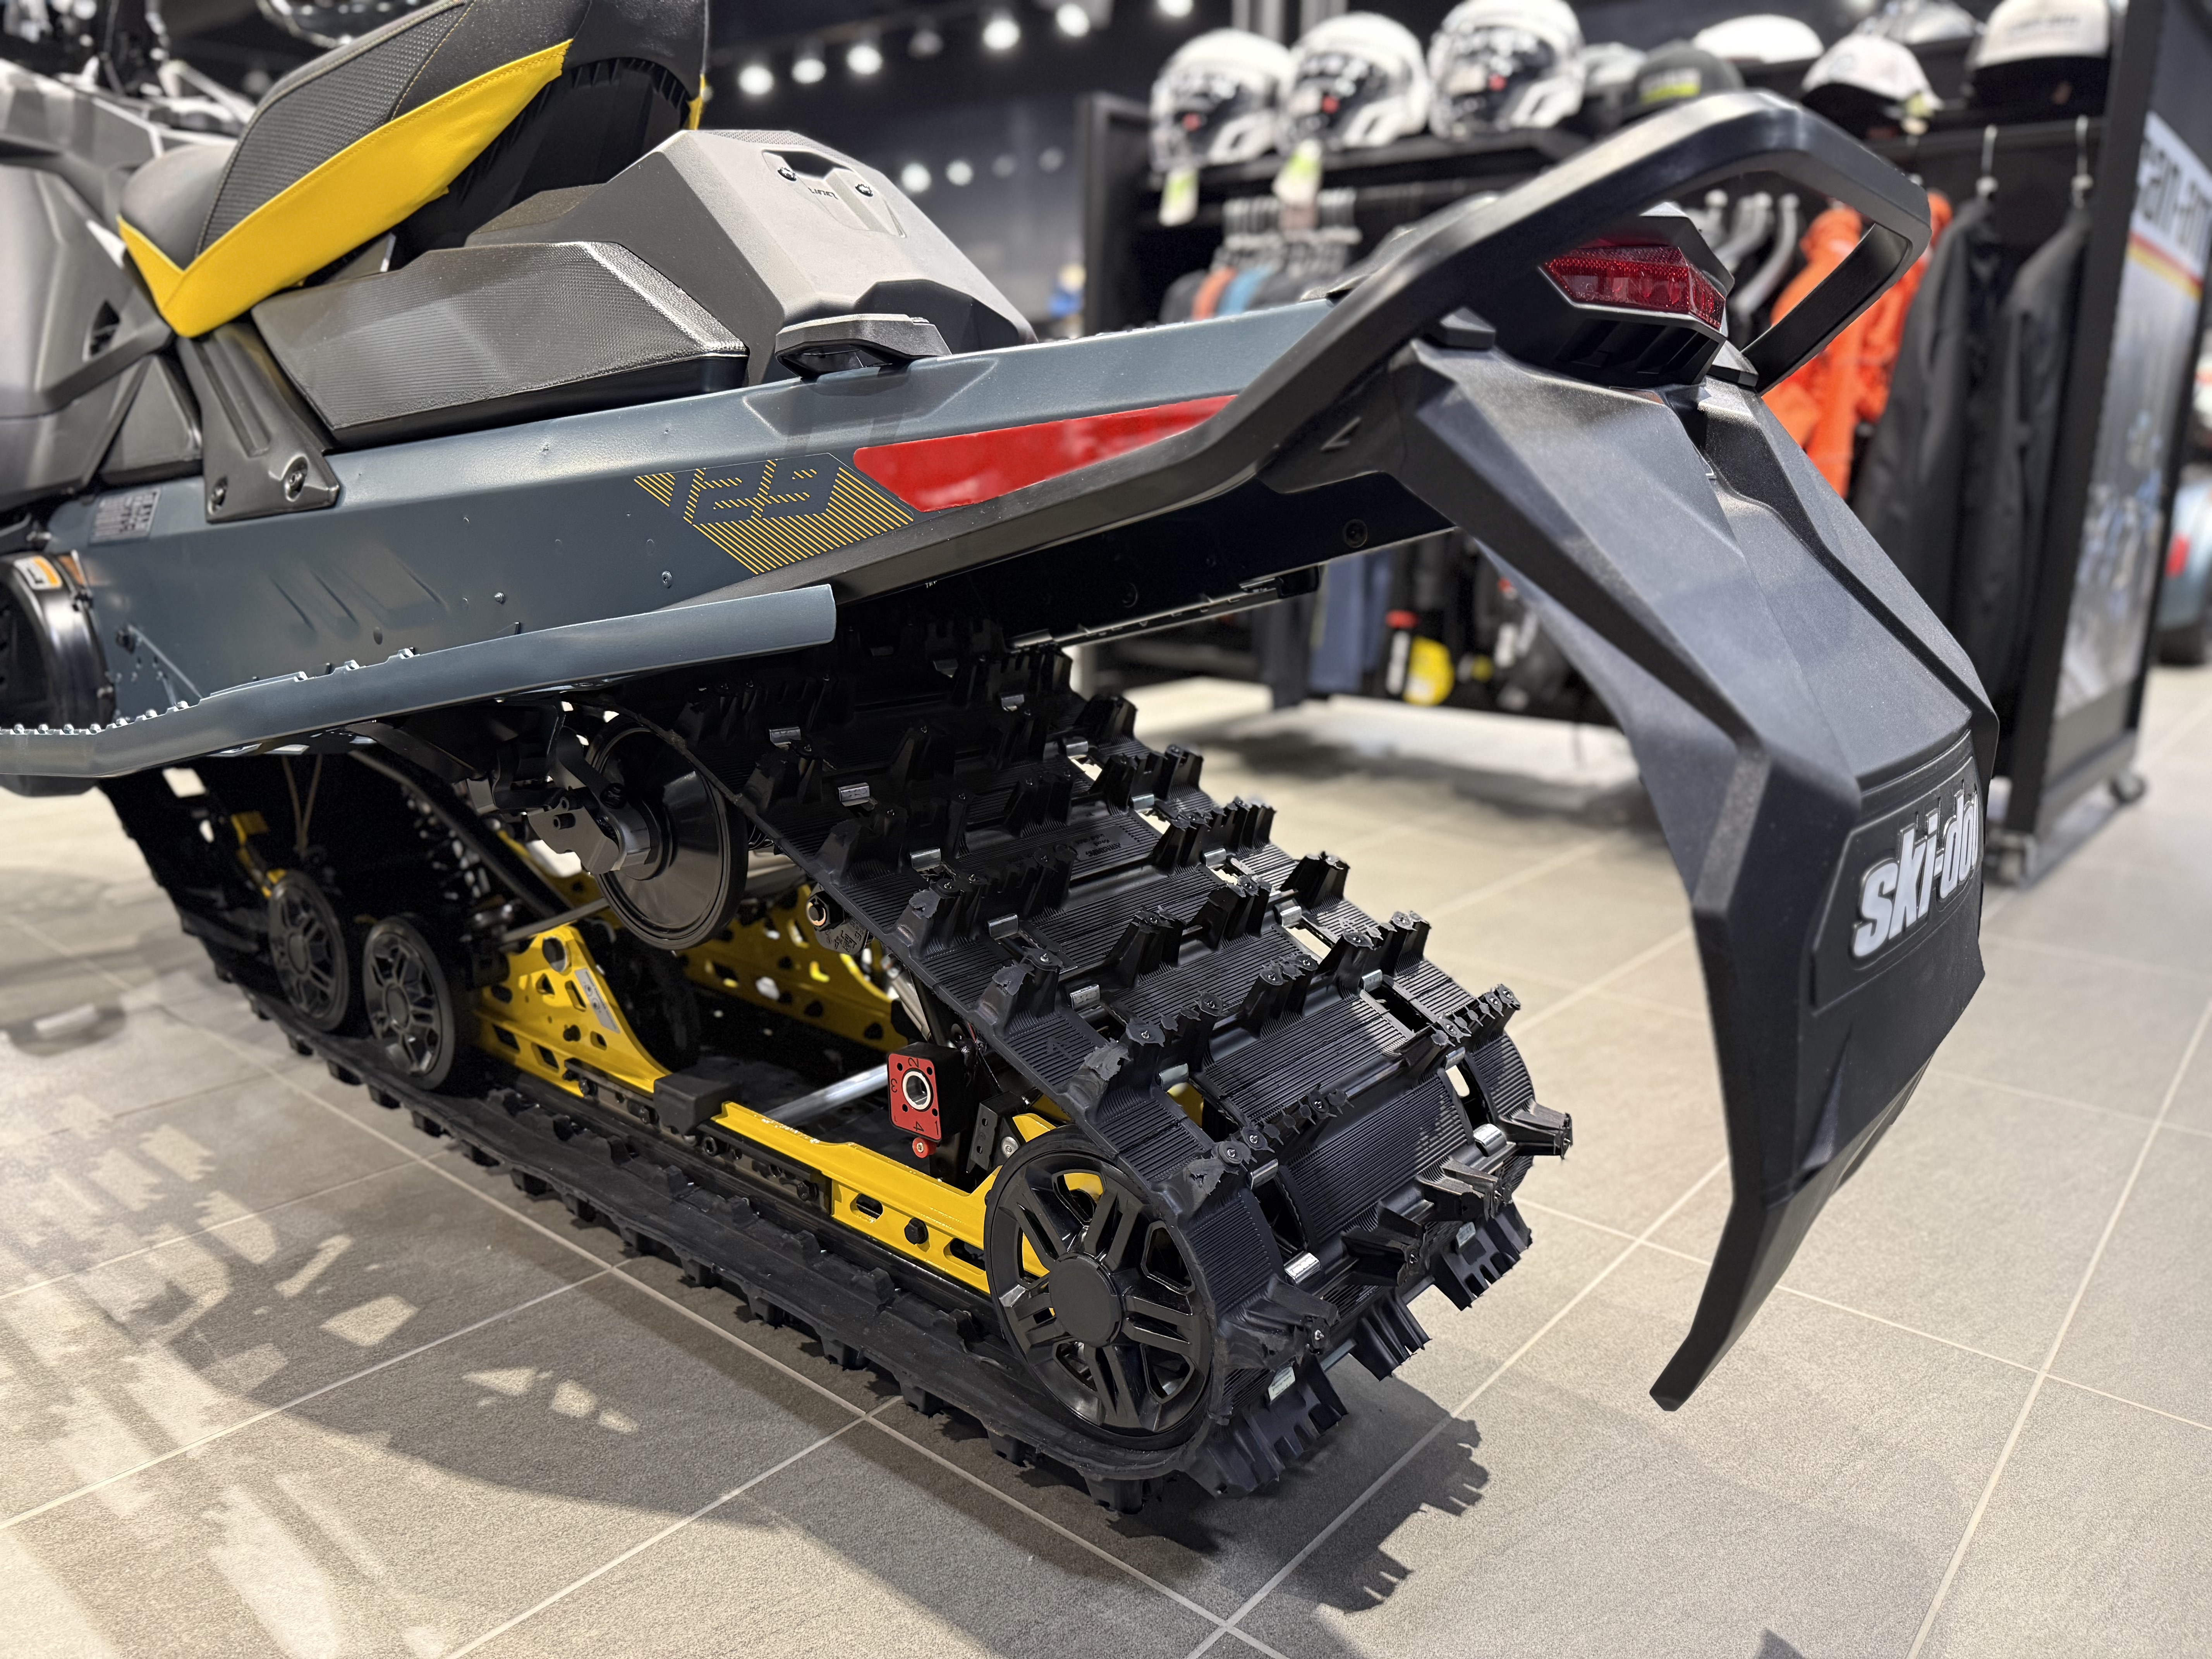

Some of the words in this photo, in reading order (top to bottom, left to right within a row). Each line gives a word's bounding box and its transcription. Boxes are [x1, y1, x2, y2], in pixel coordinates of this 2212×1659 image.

[908, 1057, 919, 1068] 2
[891, 1078, 898, 1093] 3
[913, 1121, 924, 1132] 4
[934, 1120, 939, 1135] 1
